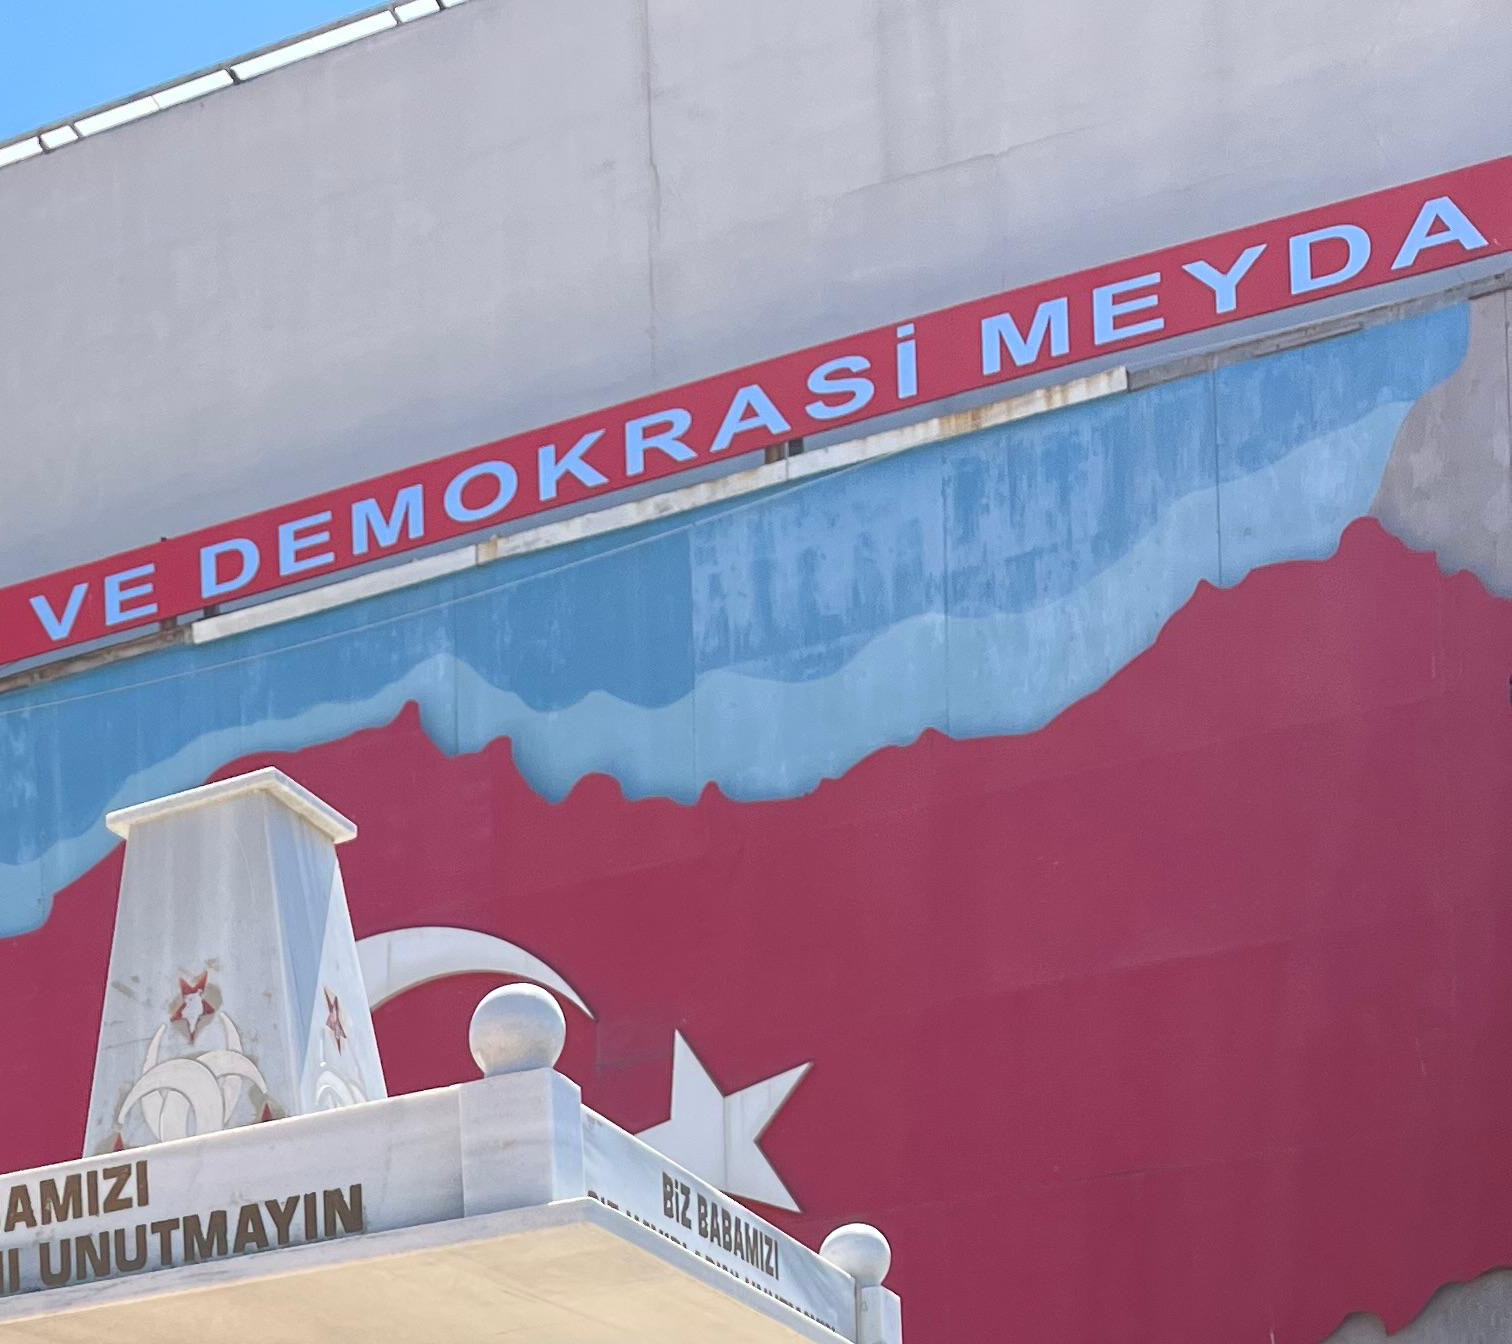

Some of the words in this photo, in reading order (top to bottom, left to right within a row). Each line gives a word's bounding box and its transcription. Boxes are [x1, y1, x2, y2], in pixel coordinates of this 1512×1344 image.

[30, 564, 159, 641] VE
[200, 323, 917, 598] DEMOKRASİ
[982, 196, 1489, 376] MEYDA
[39, 1183, 364, 1289] UNUTMAYIN
[697, 1193, 780, 1280] BABAMIZI
